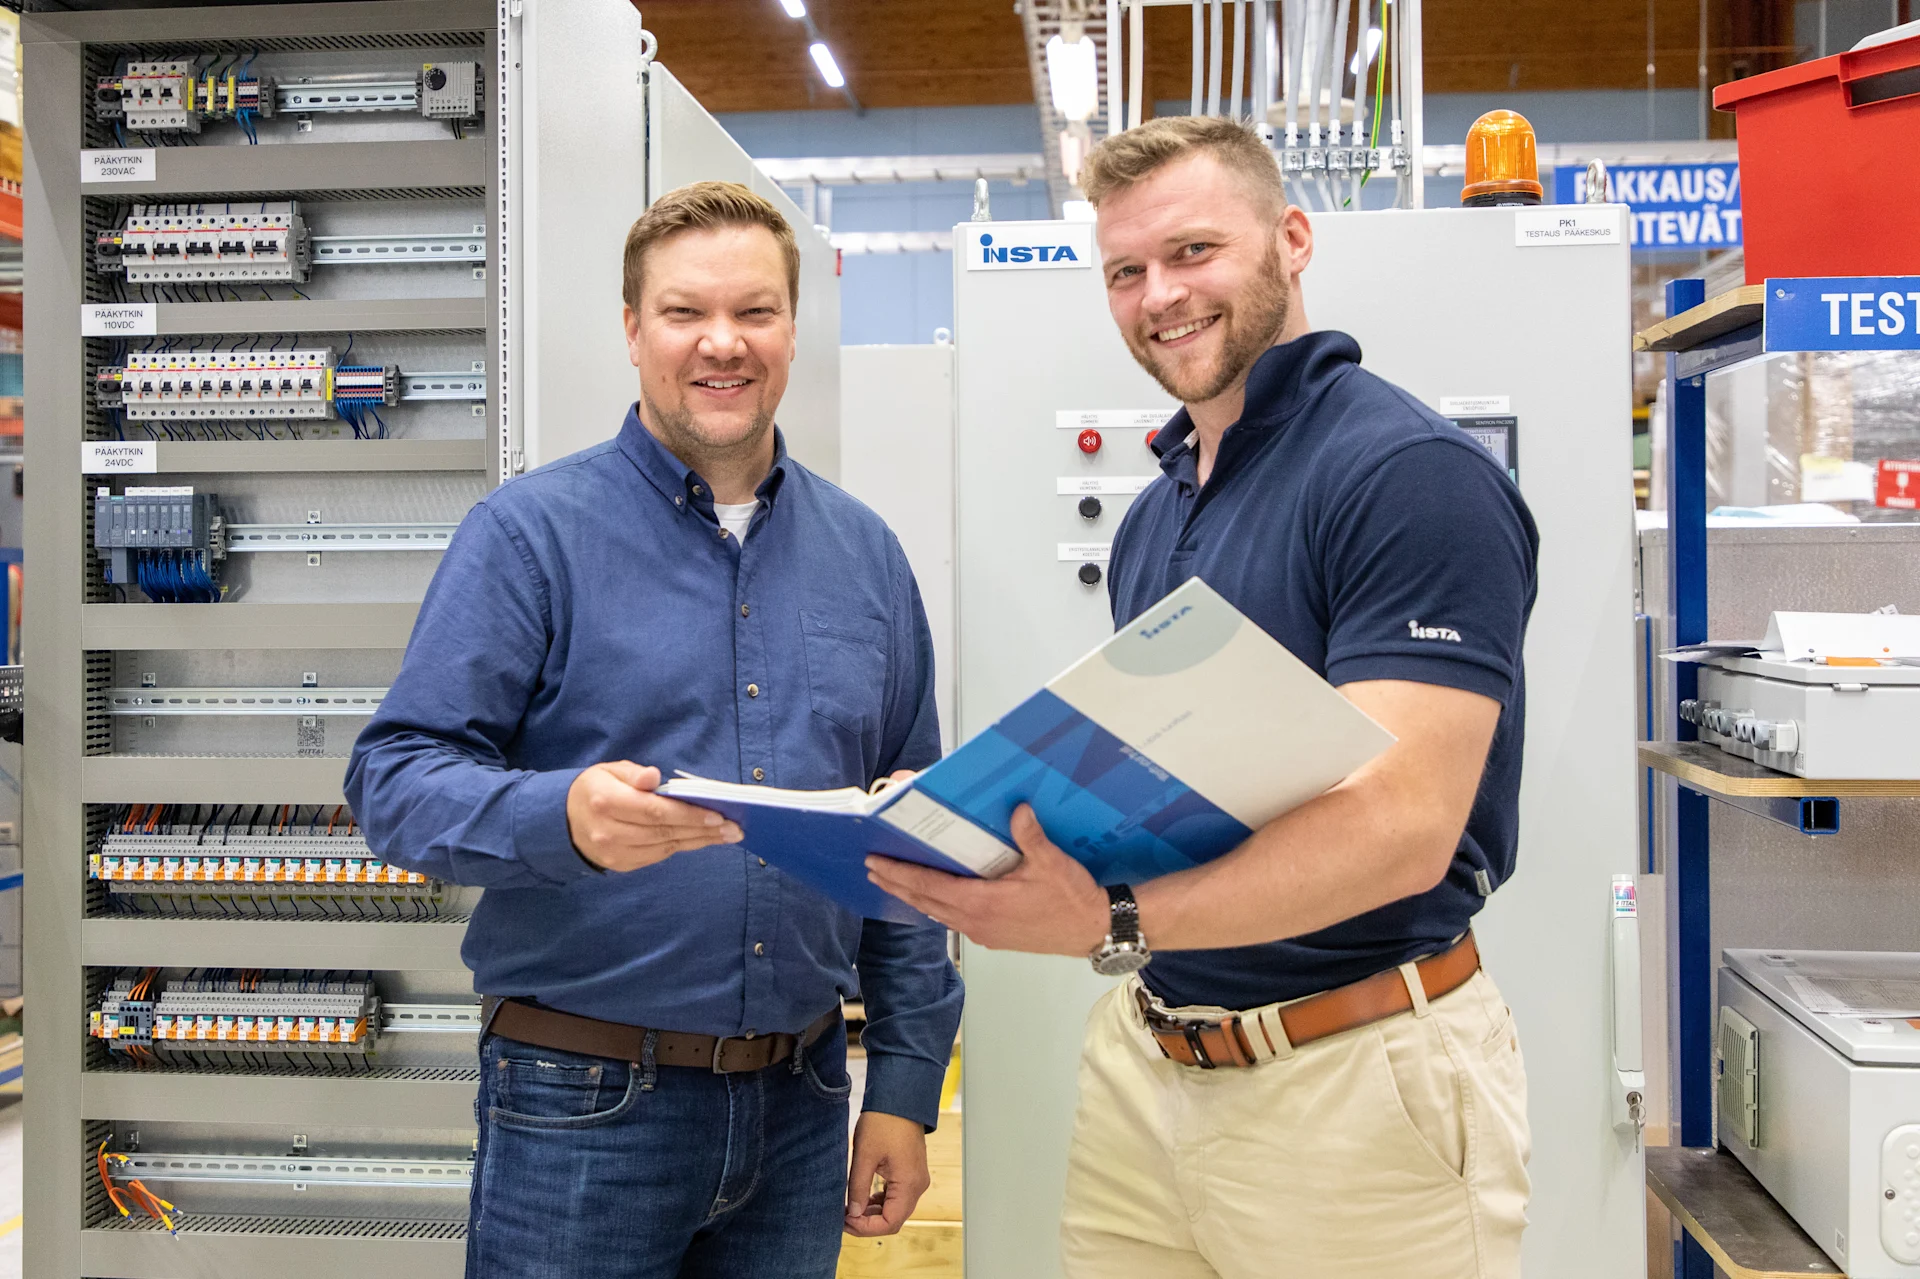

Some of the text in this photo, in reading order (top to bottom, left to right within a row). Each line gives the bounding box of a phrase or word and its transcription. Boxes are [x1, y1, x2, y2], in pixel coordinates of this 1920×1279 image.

[94, 155, 142, 165] PÄÄKYTKIN
[101, 167, 136, 176] 230VAC
[1559, 219, 1576, 227] PK1
[1525, 228, 1611, 238] TESTAUS PÄÄKESKUS
[95, 308, 143, 318] PÄÄKYTKIN
[104, 321, 135, 329] 110VDC
[95, 446, 143, 456] PÄÄKYTKIN
[104, 458, 134, 467] 24VDC
